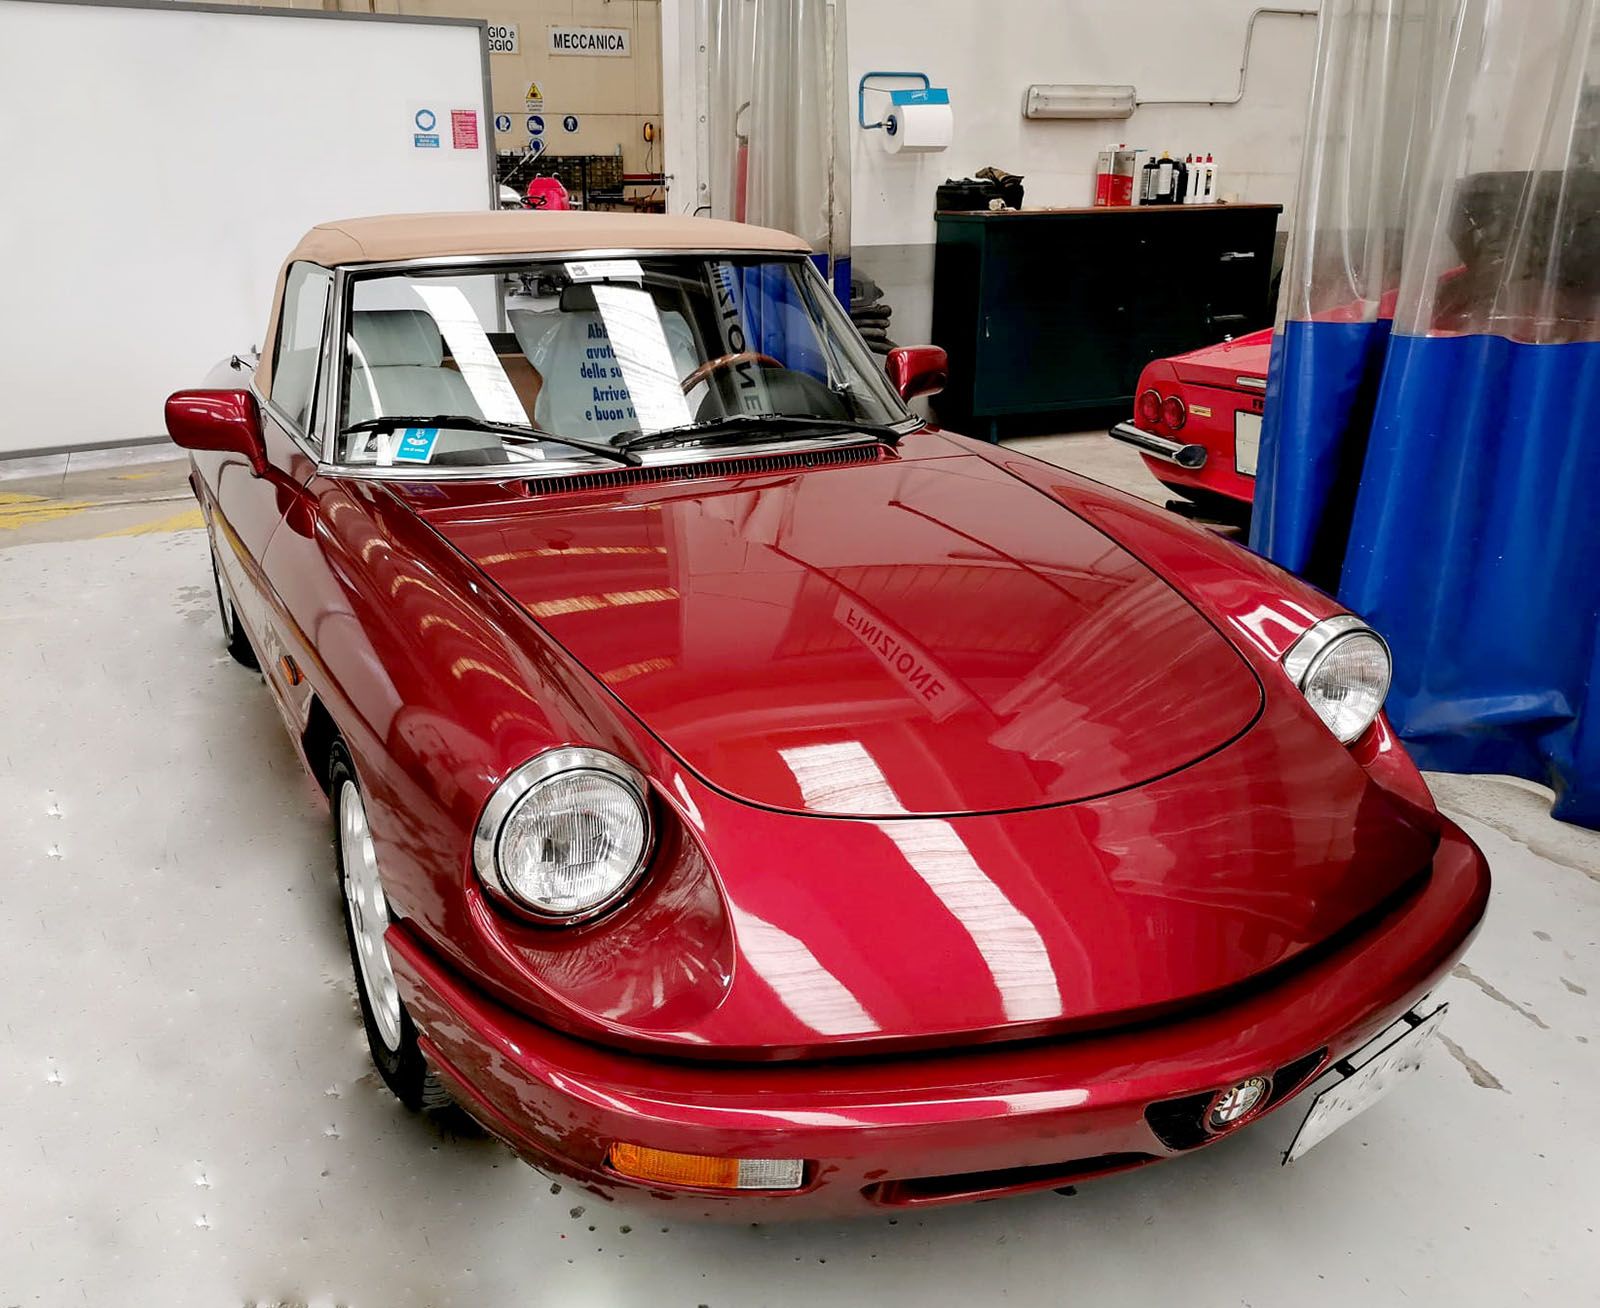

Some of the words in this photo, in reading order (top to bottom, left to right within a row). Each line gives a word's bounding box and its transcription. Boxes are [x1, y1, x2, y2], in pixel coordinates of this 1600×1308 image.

[553, 33, 625, 50] MECCANICA
[580, 361, 607, 379] della
[585, 410, 592, 421] e
[594, 404, 625, 420] buon
